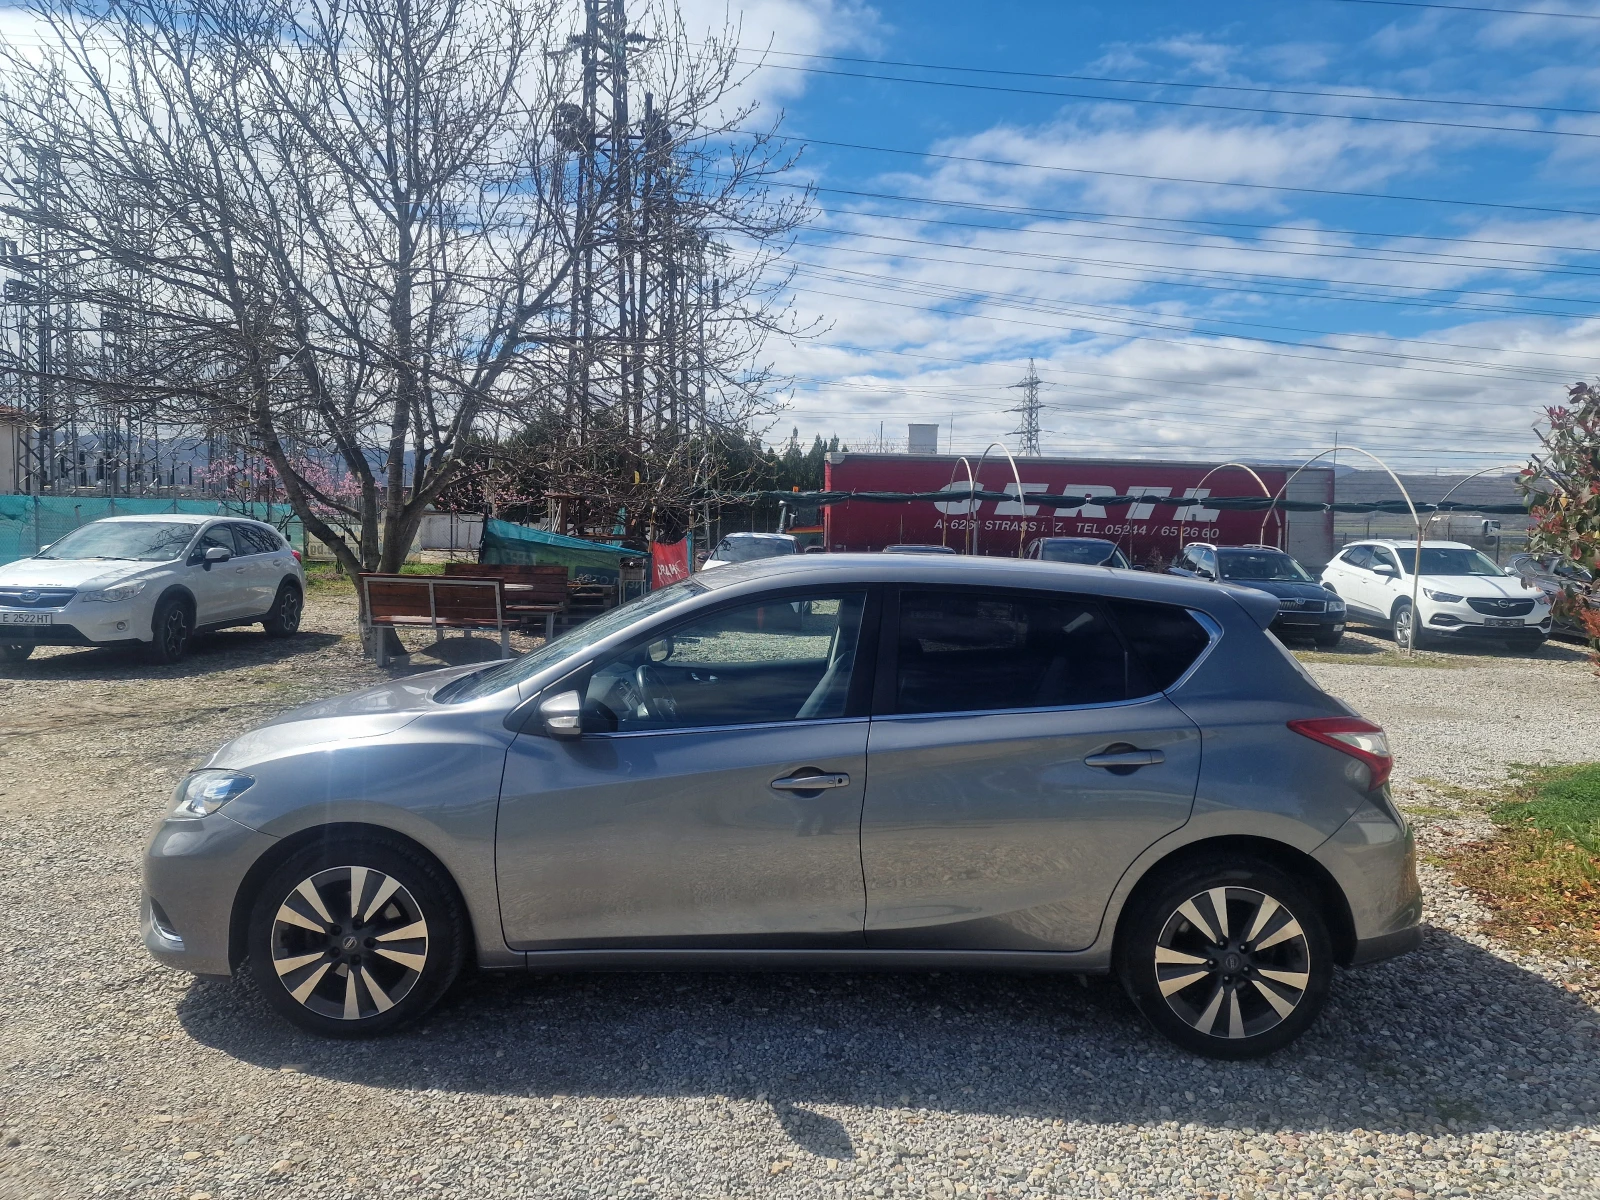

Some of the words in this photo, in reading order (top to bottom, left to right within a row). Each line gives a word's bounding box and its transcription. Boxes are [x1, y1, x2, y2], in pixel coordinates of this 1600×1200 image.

[985, 520, 1037, 532] STRASS
[1161, 526, 1178, 537] 65
[1182, 526, 1202, 538] 26
[1202, 528, 1219, 538] 60
[2, 613, 9, 623] E
[13, 614, 36, 623] 2522
[36, 614, 49, 624] HT
